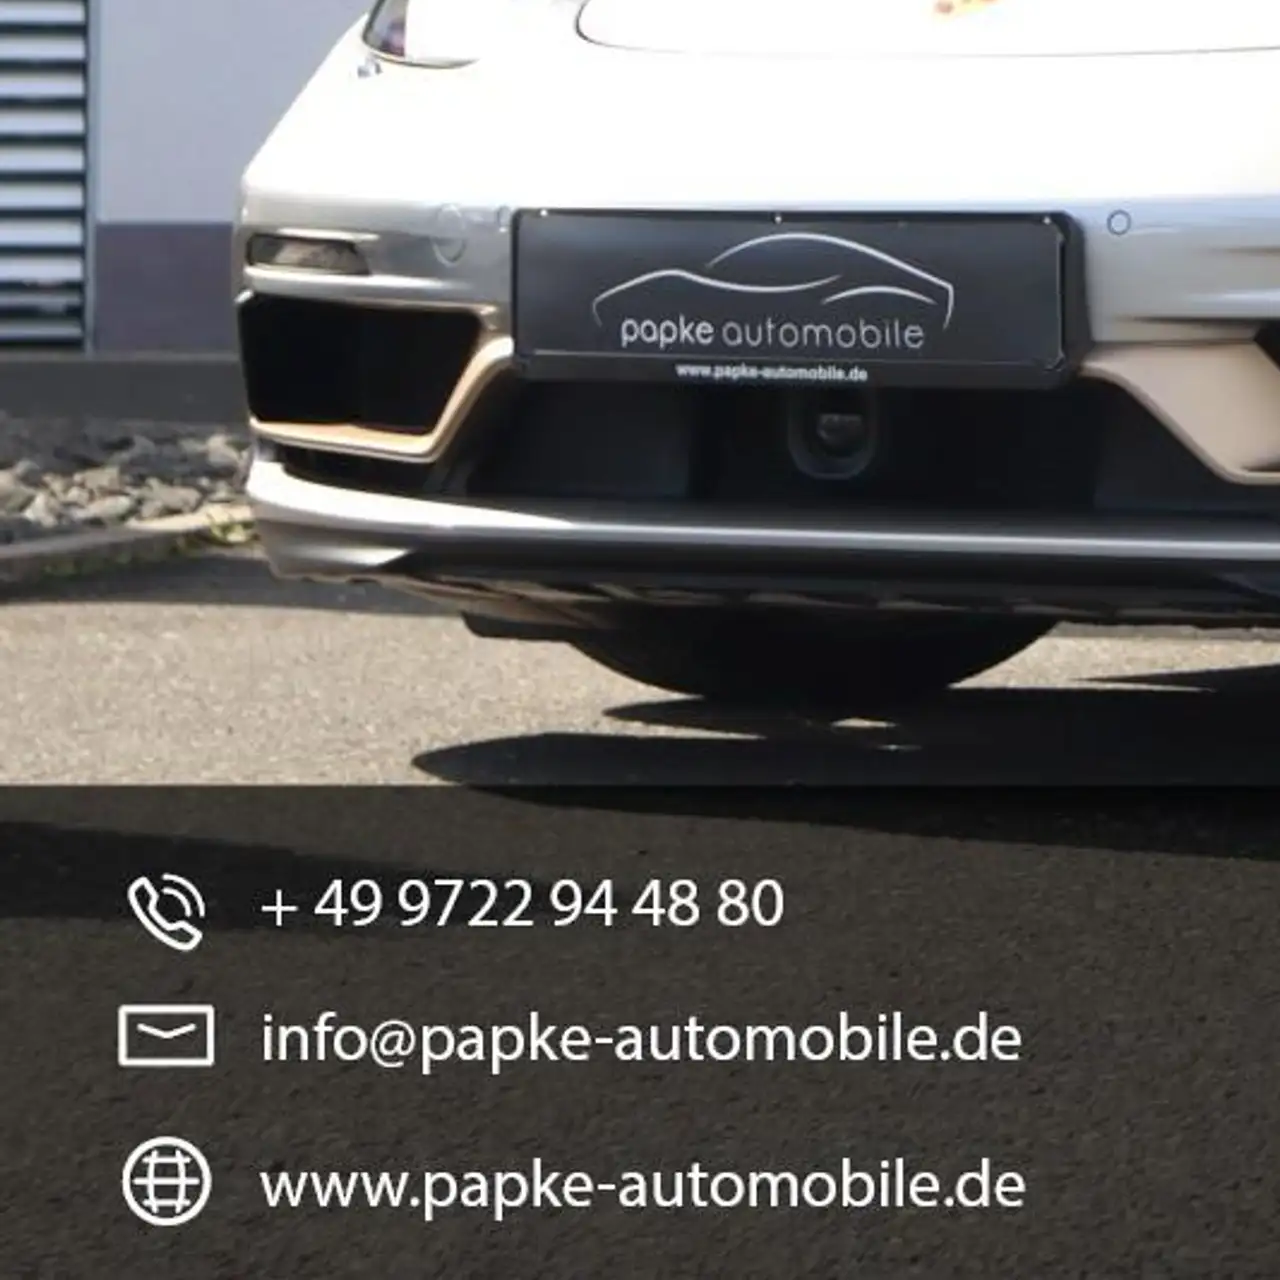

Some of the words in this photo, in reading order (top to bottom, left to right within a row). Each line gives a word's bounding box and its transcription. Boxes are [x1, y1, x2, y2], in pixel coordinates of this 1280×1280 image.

[620, 313, 715, 350] papke
[722, 316, 925, 350] automobile
[674, 362, 870, 383] www.papke-automobile.de
